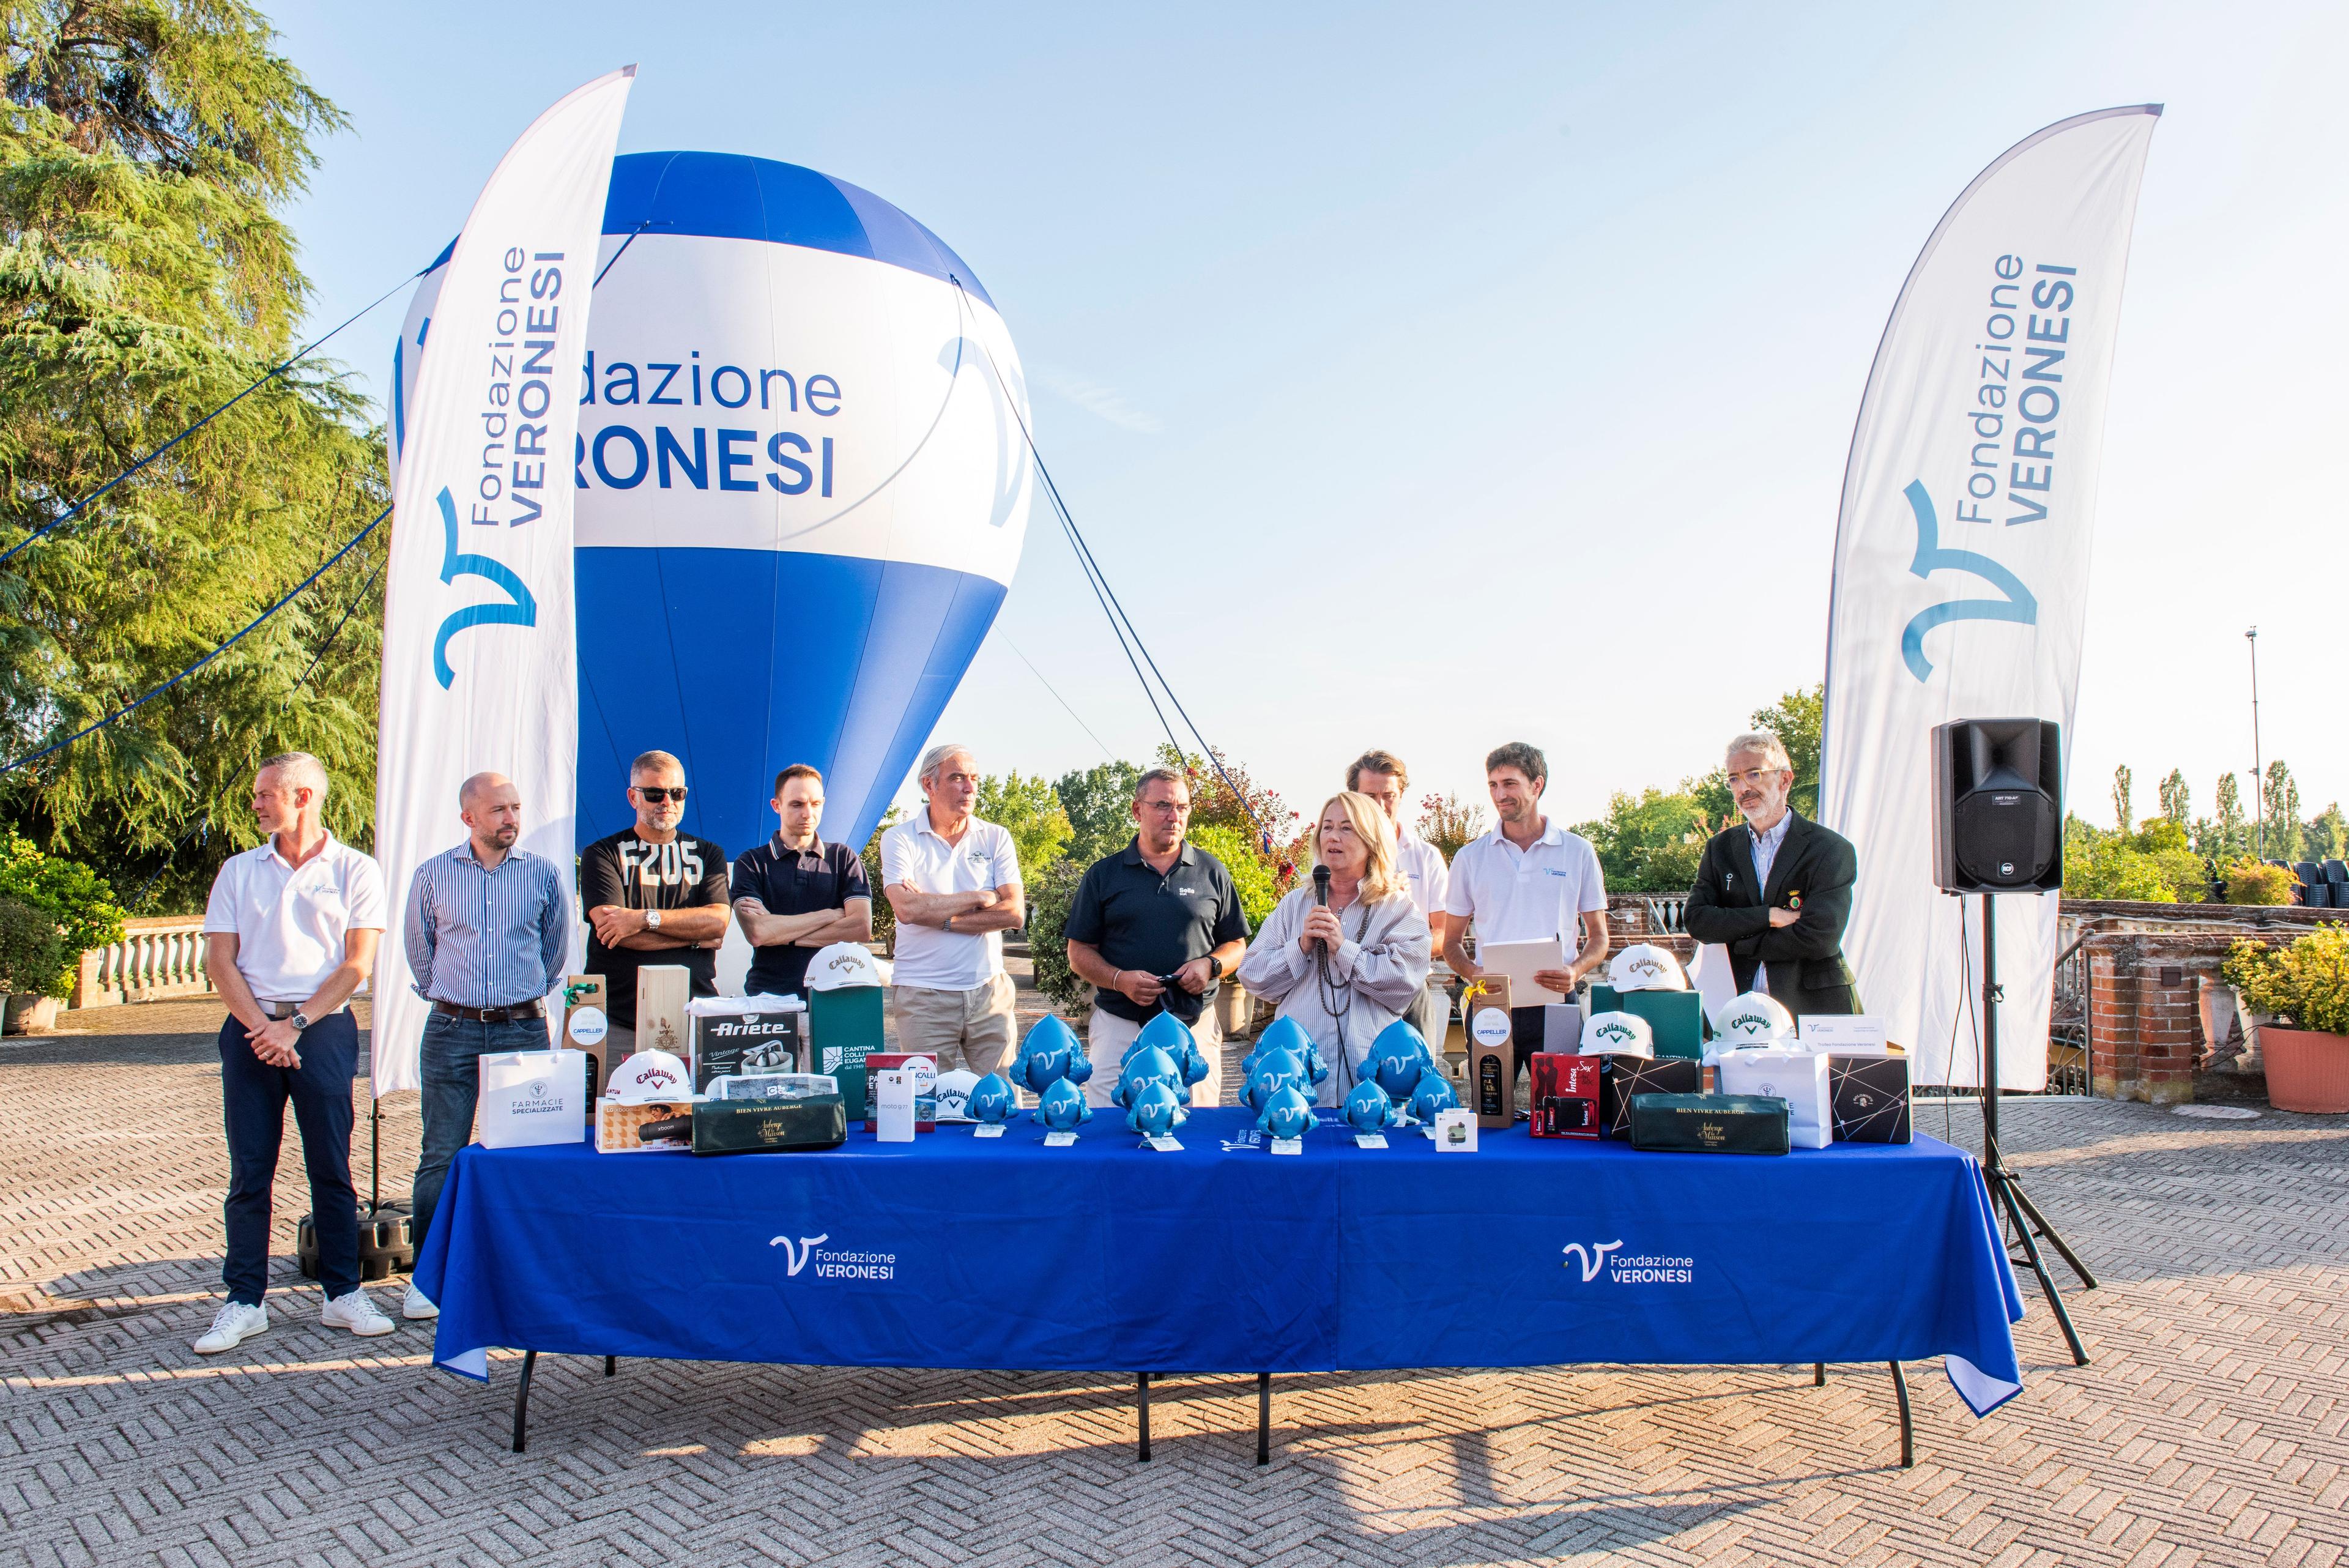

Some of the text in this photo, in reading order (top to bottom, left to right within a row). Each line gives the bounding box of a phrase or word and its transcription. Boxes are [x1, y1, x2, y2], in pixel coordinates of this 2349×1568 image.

[471, 247, 525, 527] Fondazione
[510, 252, 565, 528] VERONESI
[579, 351, 842, 417] dazione
[1956, 254, 2024, 524] Fondazione
[2005, 263, 2077, 527] VERONESI
[574, 425, 834, 498] ONESI
[617, 839, 703, 886] F205
[829, 955, 866, 970] Callaway
[1629, 958, 1668, 973] Callaway
[1731, 1013, 1772, 1029] Callaway
[710, 1022, 791, 1036] Ariete
[1595, 1023, 1636, 1040] Callaway
[709, 1047, 740, 1058] Vintage
[636, 1068, 677, 1084] Callaway
[1565, 1060, 1594, 1093] Intesa Sex
[512, 1098, 563, 1107] FARMACIE
[937, 1088, 971, 1102] Callawa
[512, 1106, 563, 1115] SPECIALIZZATE
[757, 1119, 783, 1131] Auberge
[761, 1128, 785, 1137] Maison
[1696, 1122, 1724, 1135] Auberge
[1701, 1131, 1725, 1140] Maison
[815, 1249, 896, 1263] Fondazione
[1610, 1254, 1694, 1267] Fondazione
[815, 1264, 894, 1279] VERONESI
[1610, 1269, 1692, 1283] VERONESI
